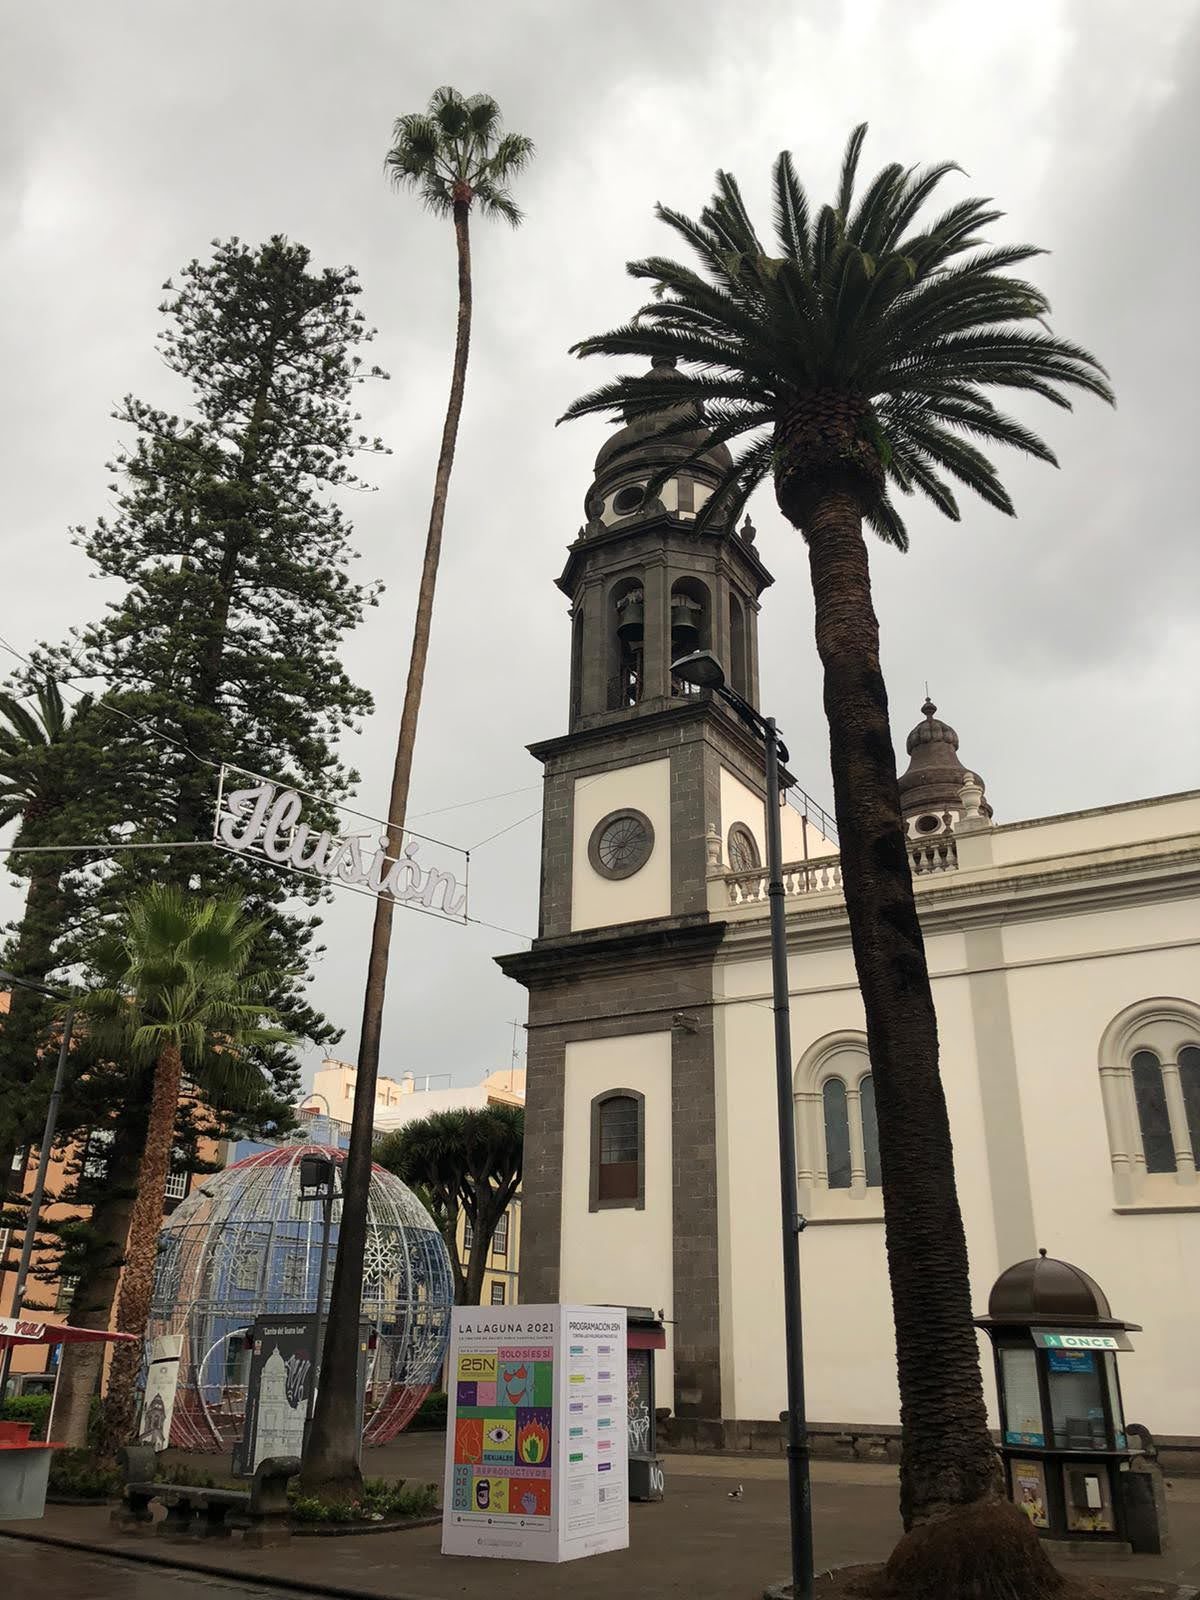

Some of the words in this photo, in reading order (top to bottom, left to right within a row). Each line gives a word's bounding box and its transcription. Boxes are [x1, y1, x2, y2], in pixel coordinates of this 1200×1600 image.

[219, 783, 466, 916] Ilusión
[459, 1324, 472, 1334] LA
[476, 1323, 523, 1334] LAGUNA
[527, 1322, 554, 1333] 2021
[1066, 1337, 1114, 1348] ONCE
[501, 1350, 521, 1359] SOLO
[522, 1348, 530, 1358] SÍ
[531, 1350, 541, 1358] ES
[461, 1357, 496, 1371] 25N
[484, 1453, 514, 1462] SEXUALES
[456, 1467, 468, 1476] YO
